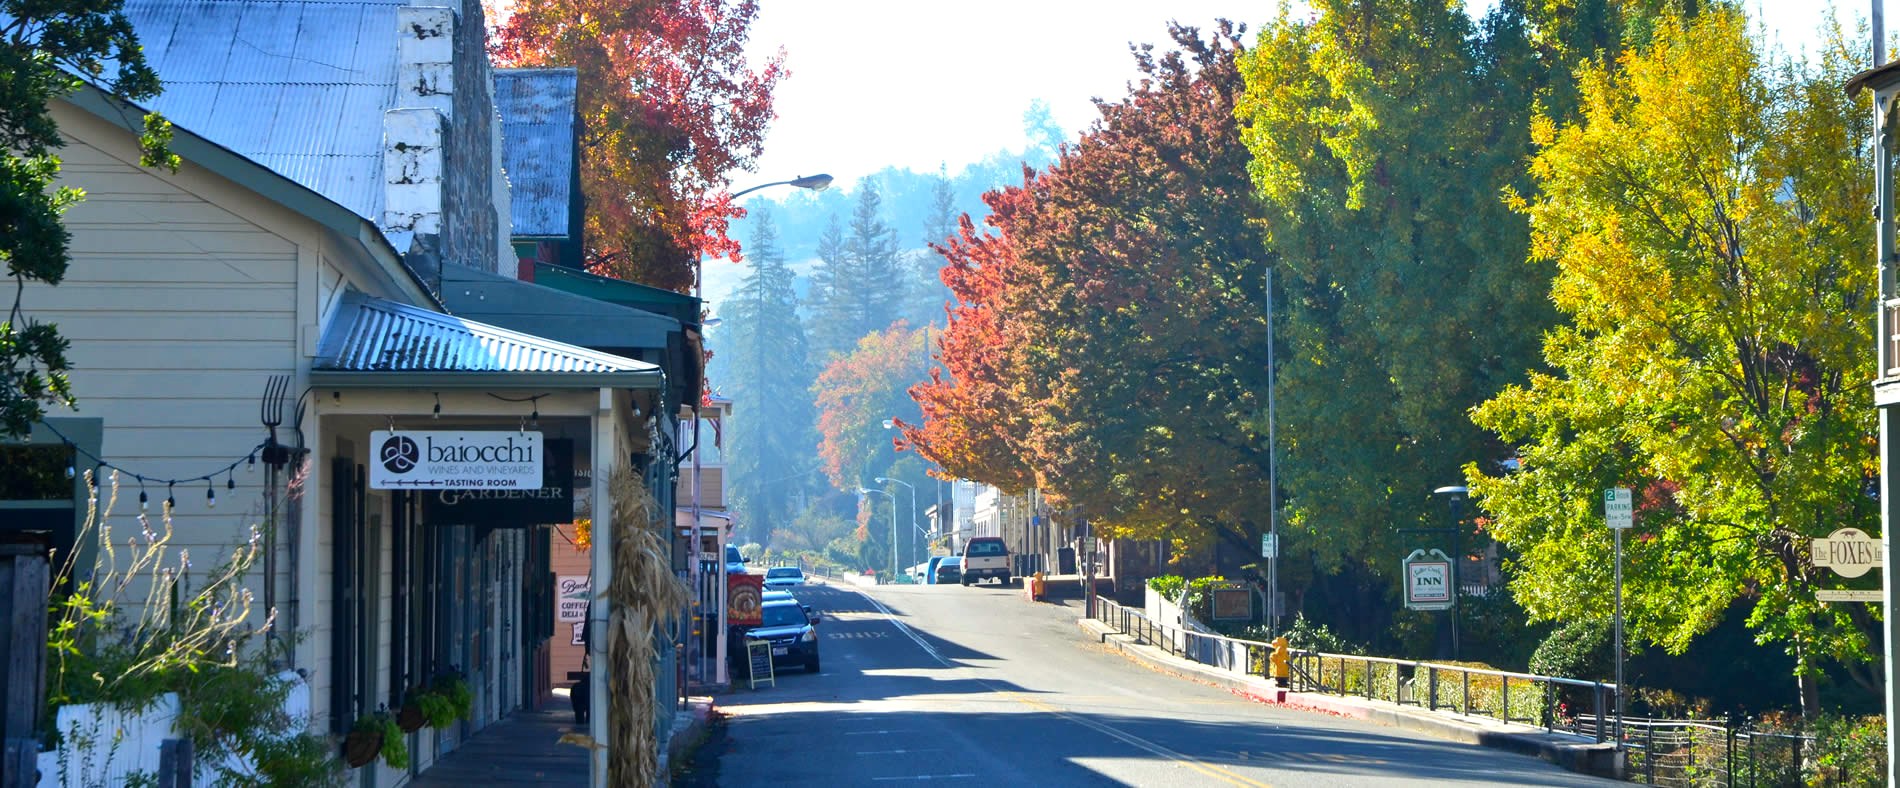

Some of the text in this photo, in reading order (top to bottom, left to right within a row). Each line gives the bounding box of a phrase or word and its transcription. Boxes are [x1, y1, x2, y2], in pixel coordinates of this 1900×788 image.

[426, 436, 534, 463] baiocchi
[428, 465, 535, 475] WINES AND VINEYARDS
[445, 479, 517, 487] TASTING ROOM
[1607, 490, 1614, 500] 2
[1607, 503, 1631, 511] PARKING
[1814, 546, 1828, 558] The
[1829, 540, 1873, 565] FOXES
[1416, 576, 1442, 586] INN
[561, 610, 579, 618] DELI
